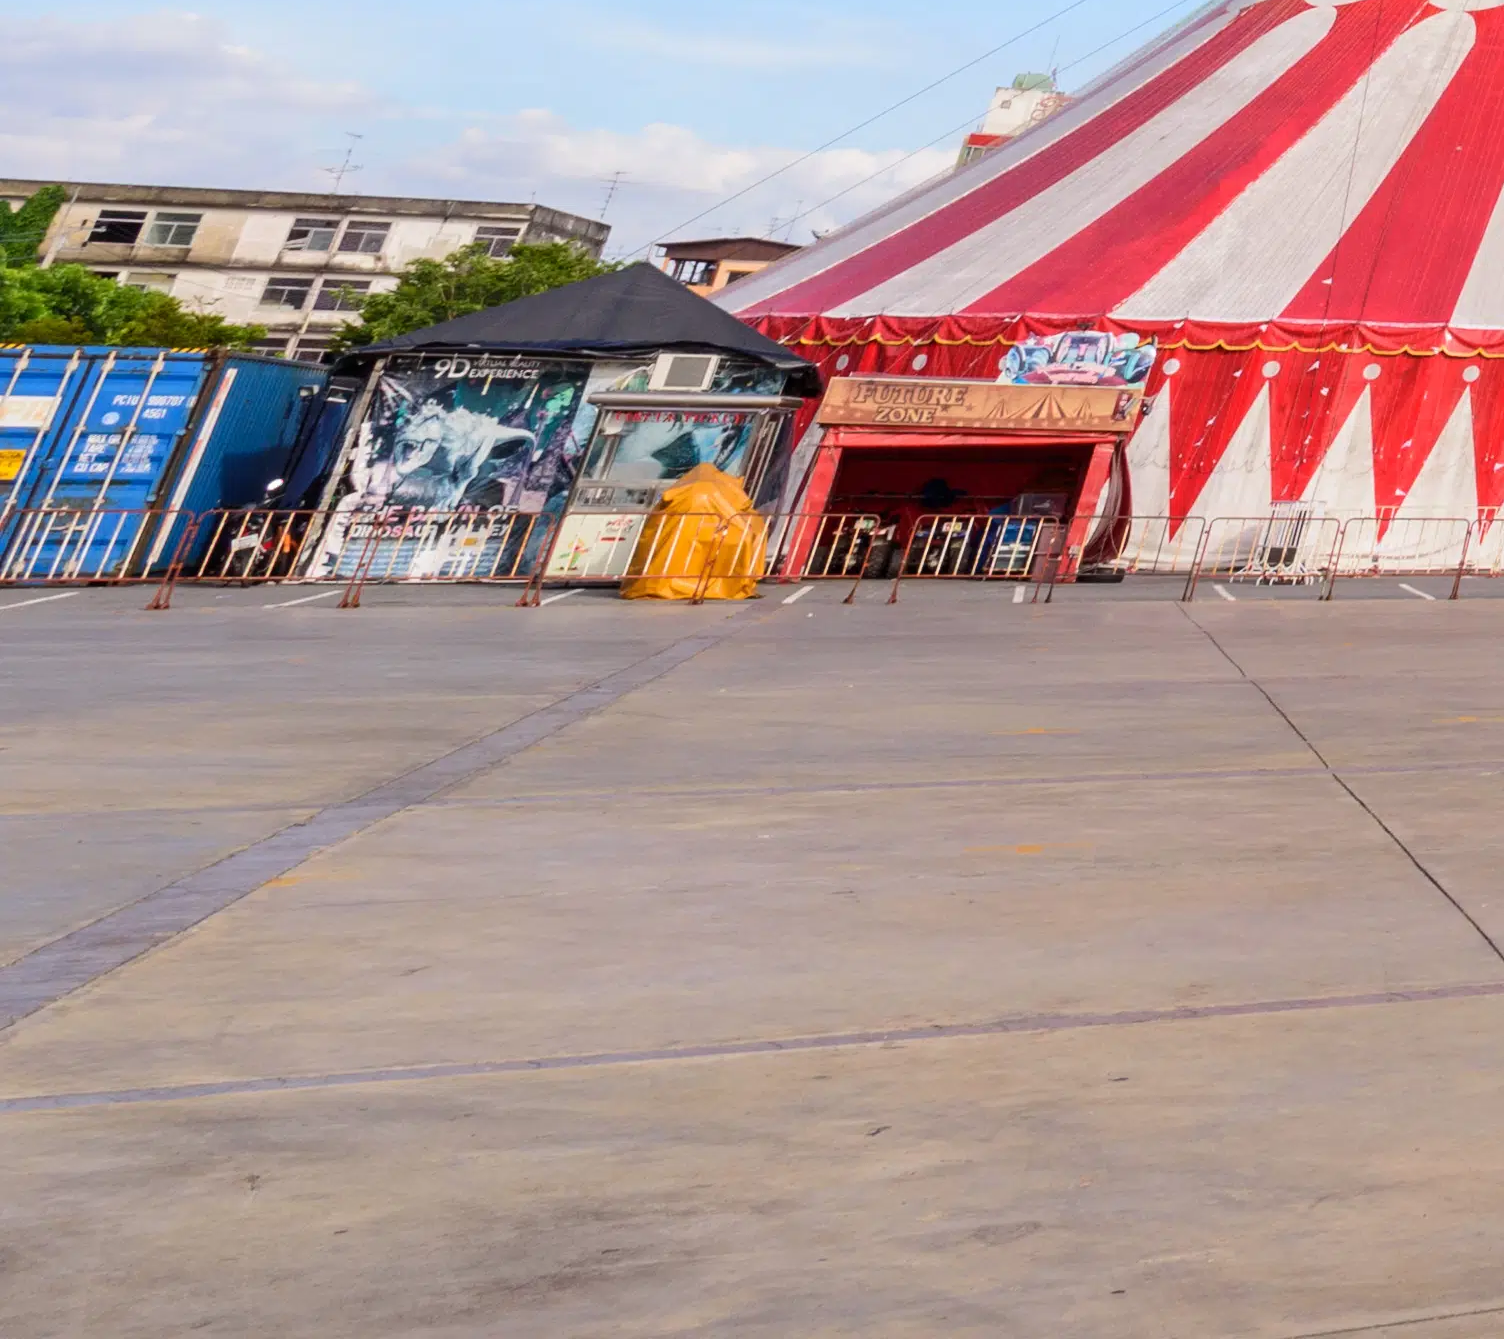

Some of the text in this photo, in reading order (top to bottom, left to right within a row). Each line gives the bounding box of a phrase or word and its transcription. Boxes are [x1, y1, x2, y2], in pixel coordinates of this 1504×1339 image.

[434, 358, 470, 380] 9D
[468, 368, 540, 380] EXPERIENCE
[853, 383, 968, 406] FUTURE
[873, 405, 938, 424] ZONE
